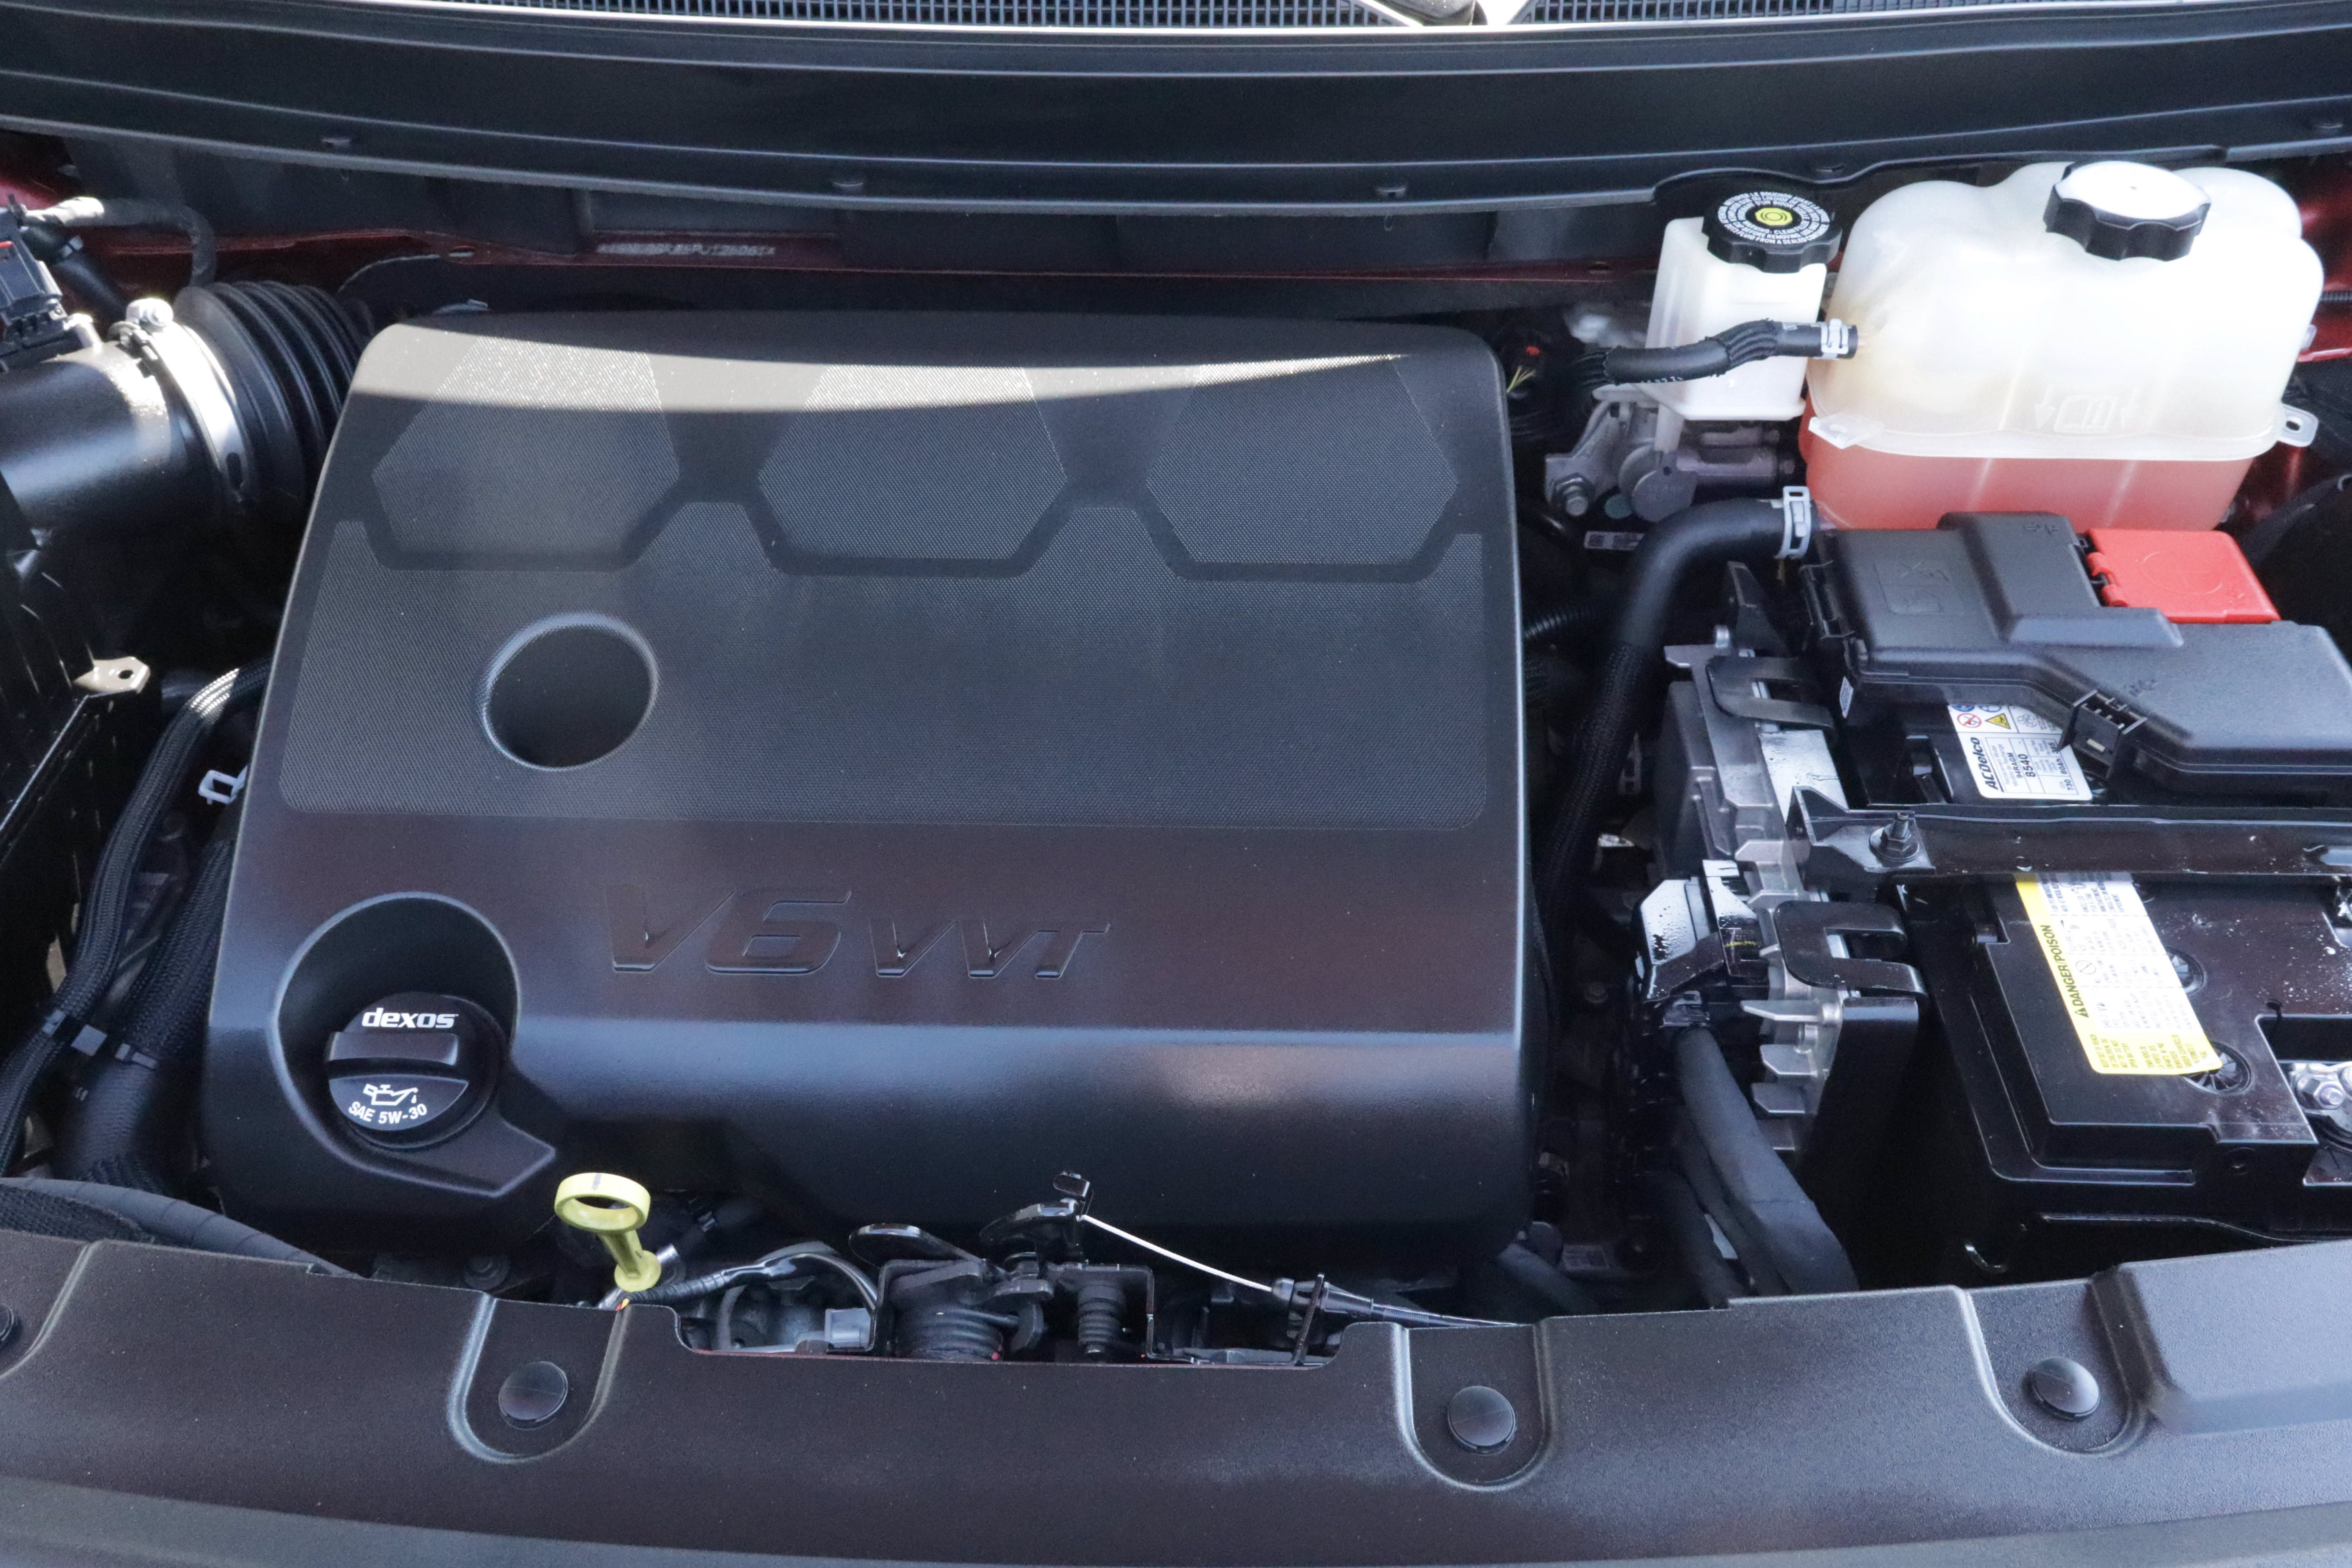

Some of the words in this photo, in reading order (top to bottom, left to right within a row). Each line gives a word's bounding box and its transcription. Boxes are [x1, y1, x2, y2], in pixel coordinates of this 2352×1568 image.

[1971, 737, 1998, 789] ACDelco
[2007, 753, 2022, 778] 94RAGM
[2018, 754, 2036, 777] 8540
[2056, 758, 2067, 774] 80Ah
[2064, 780, 2074, 790] 730
[606, 884, 853, 976] V6
[866, 916, 1112, 980] VVT
[362, 1007, 456, 1029] dexos
[348, 1101, 375, 1122] SAE
[378, 1103, 428, 1124] 5W-30
